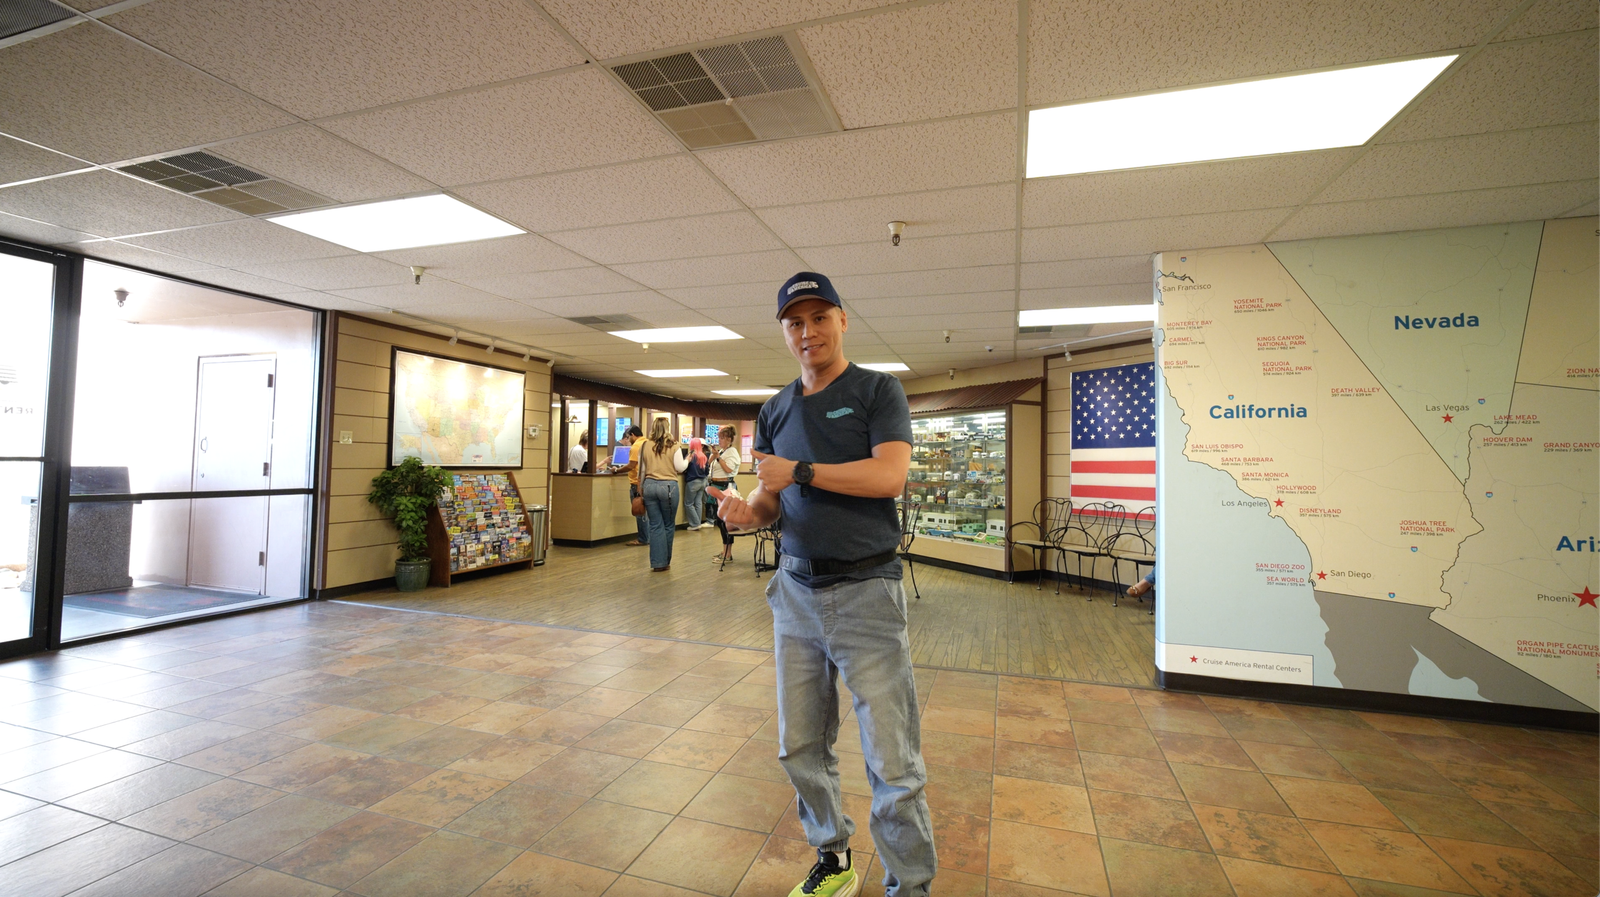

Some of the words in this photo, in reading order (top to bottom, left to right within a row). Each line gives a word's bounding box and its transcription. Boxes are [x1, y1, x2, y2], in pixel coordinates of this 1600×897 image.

[1394, 312, 1479, 330] Nevada
[1209, 403, 1307, 419] California
[1443, 404, 1470, 412] Vegas
[1237, 500, 1268, 508] Angeles
[1348, 570, 1371, 579] Diego
[1537, 594, 1576, 602] Phoenix
[1517, 646, 1557, 654] NATIONAL
[1567, 643, 1599, 651] CACTUS
[1224, 660, 1252, 668] America
[1275, 665, 1302, 673] Centers
